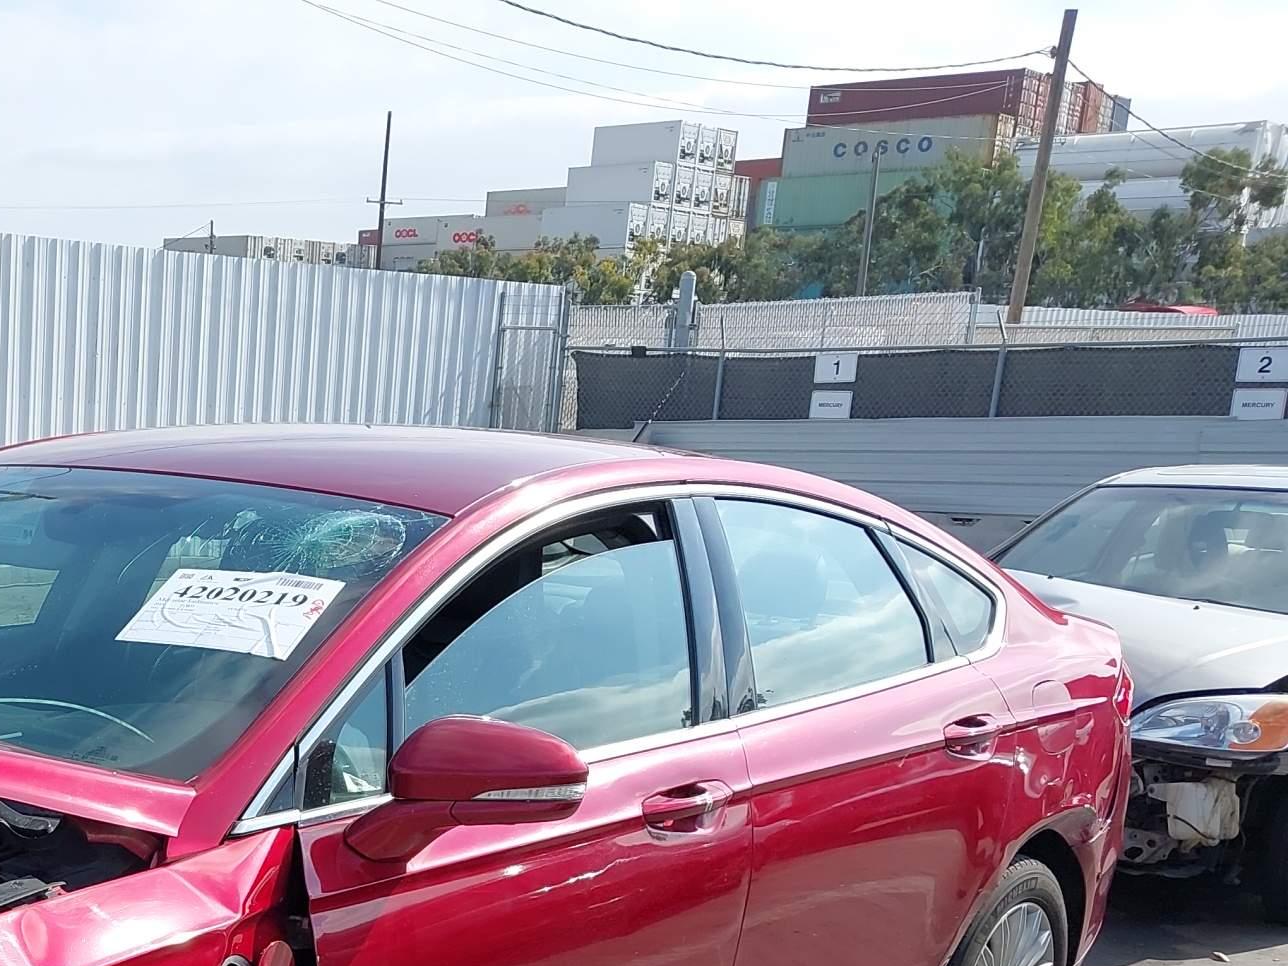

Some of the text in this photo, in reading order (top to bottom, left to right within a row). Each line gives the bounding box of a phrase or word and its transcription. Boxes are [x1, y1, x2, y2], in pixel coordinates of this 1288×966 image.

[833, 136, 933, 158] COSCO
[395, 228, 418, 239] OOCL
[833, 360, 840, 375] 1
[1257, 356, 1272, 373] 2
[174, 585, 309, 607] 42020219
